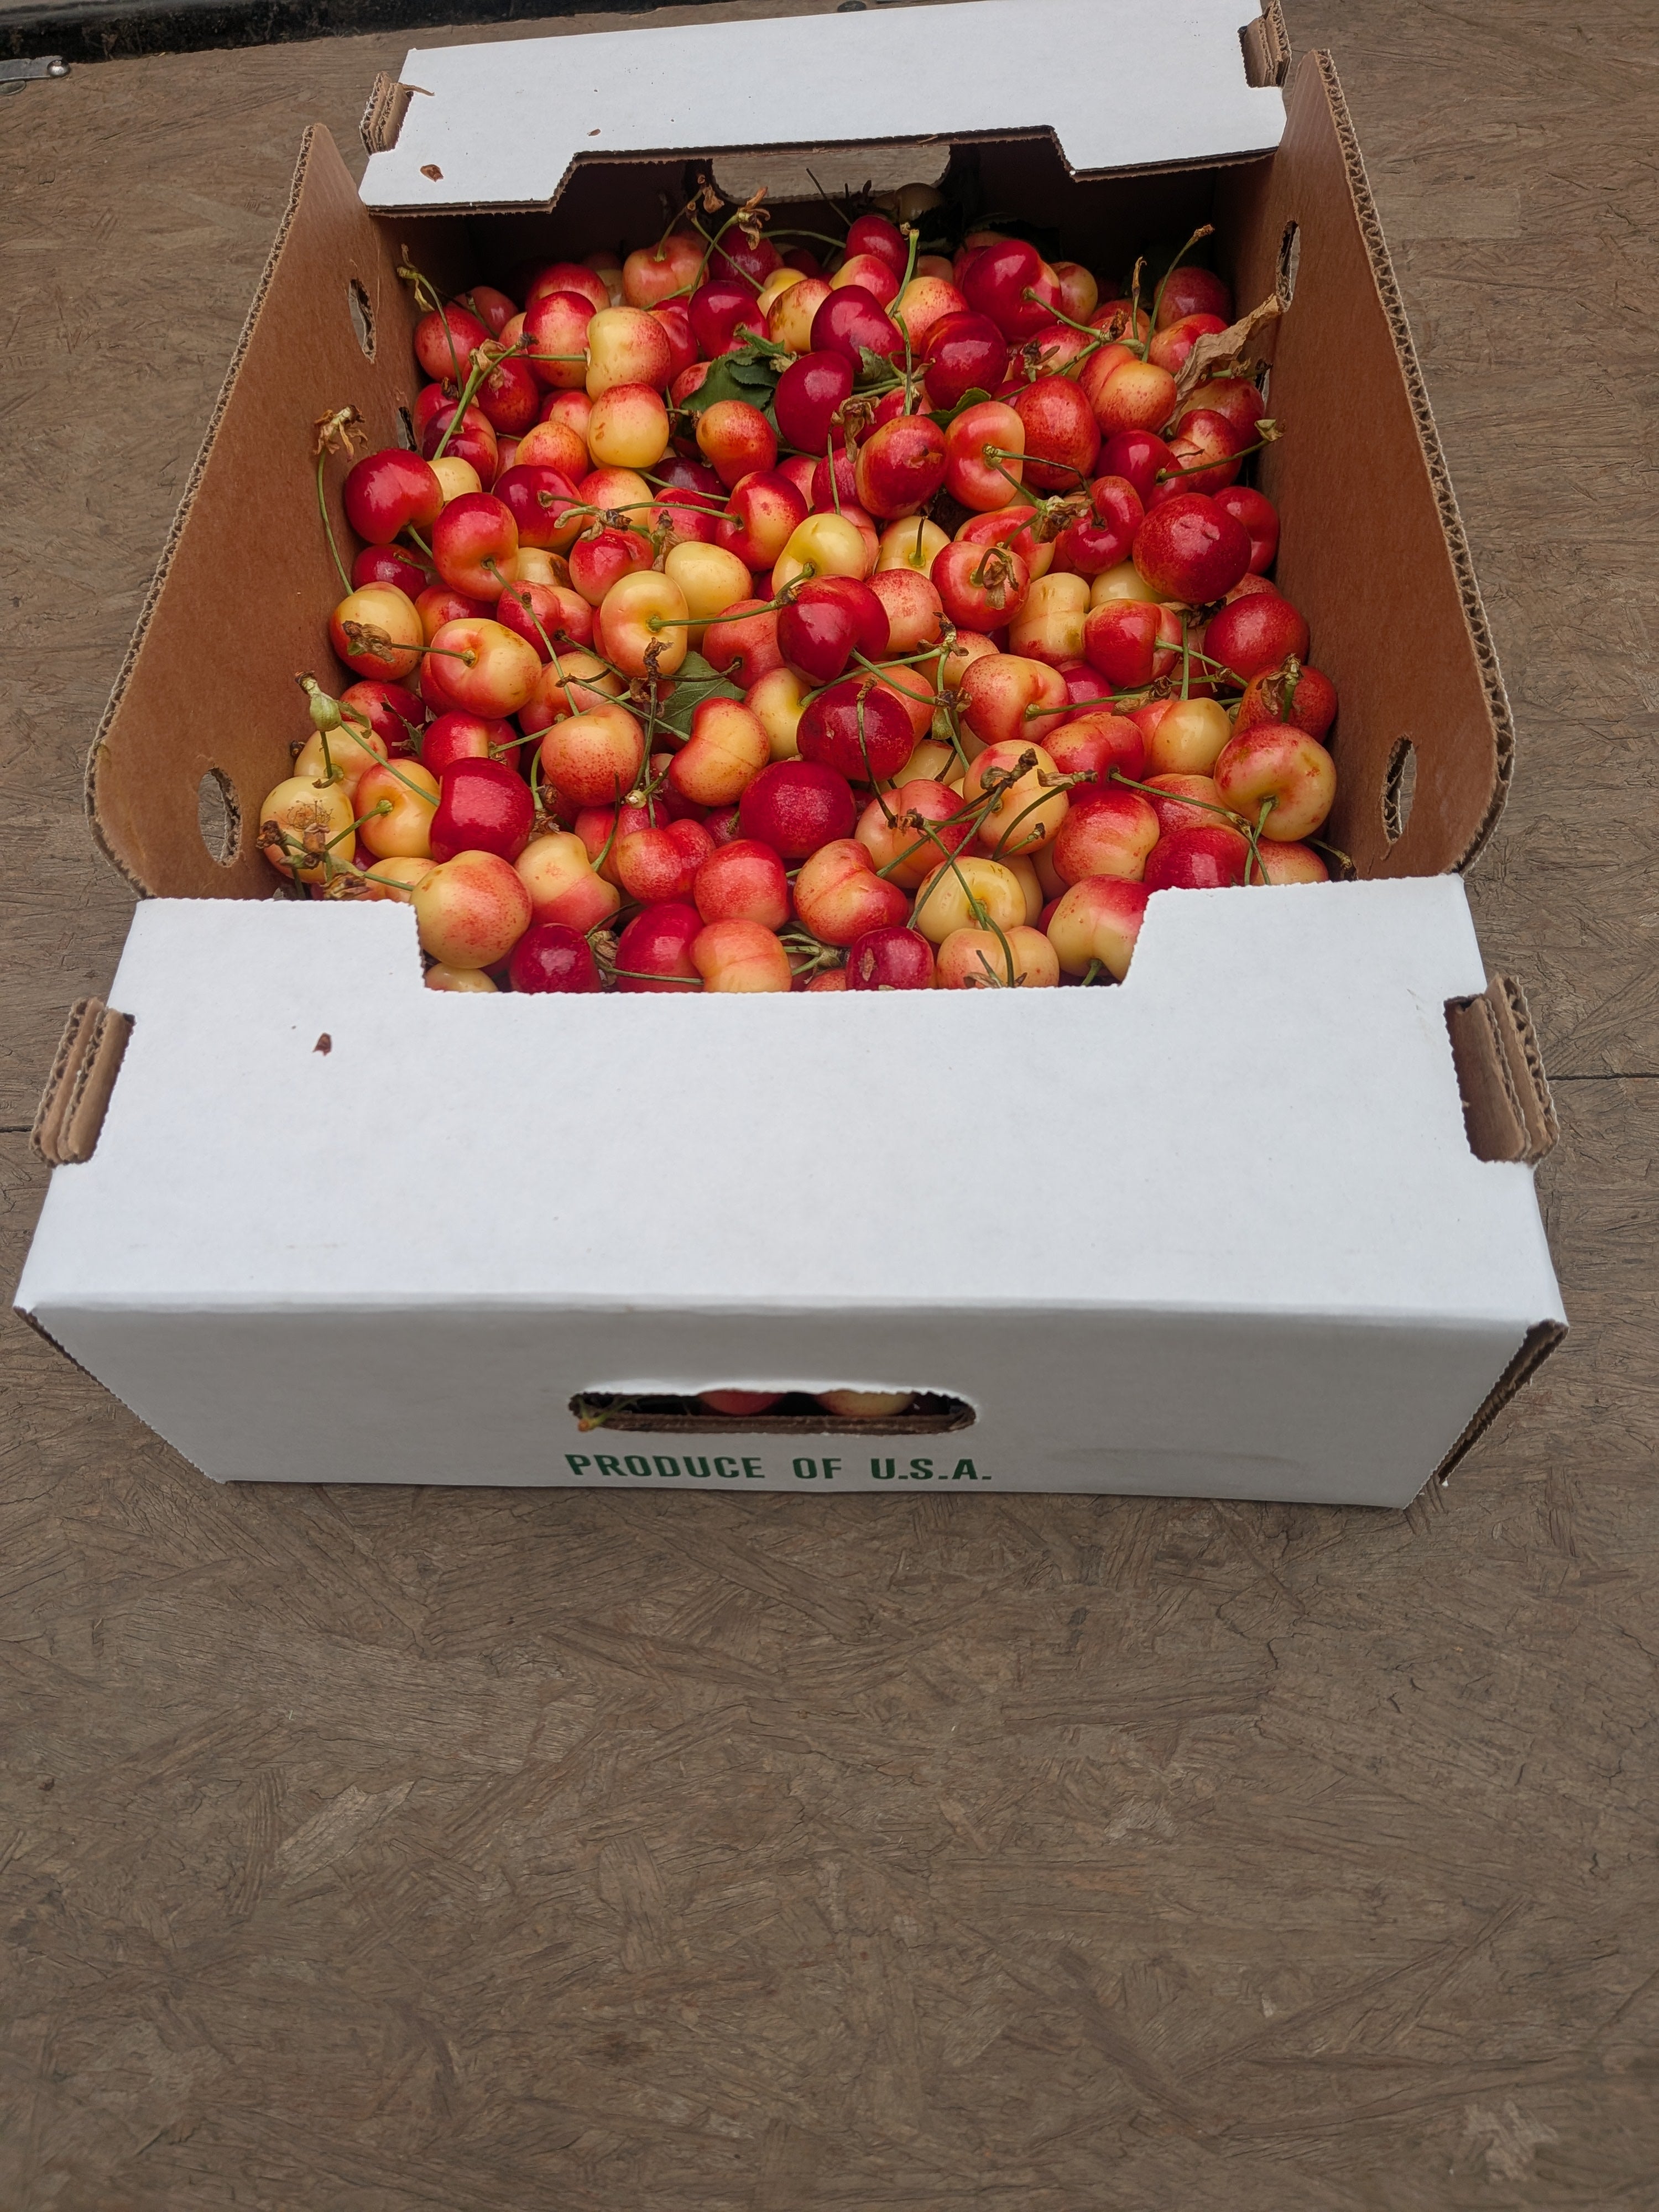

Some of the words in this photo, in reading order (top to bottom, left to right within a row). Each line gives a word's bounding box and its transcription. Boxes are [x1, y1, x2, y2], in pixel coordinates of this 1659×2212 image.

[564, 1453, 766, 1479] PRODUCE
[792, 1457, 842, 1479] OF
[870, 1457, 992, 1480] U.S.A.
